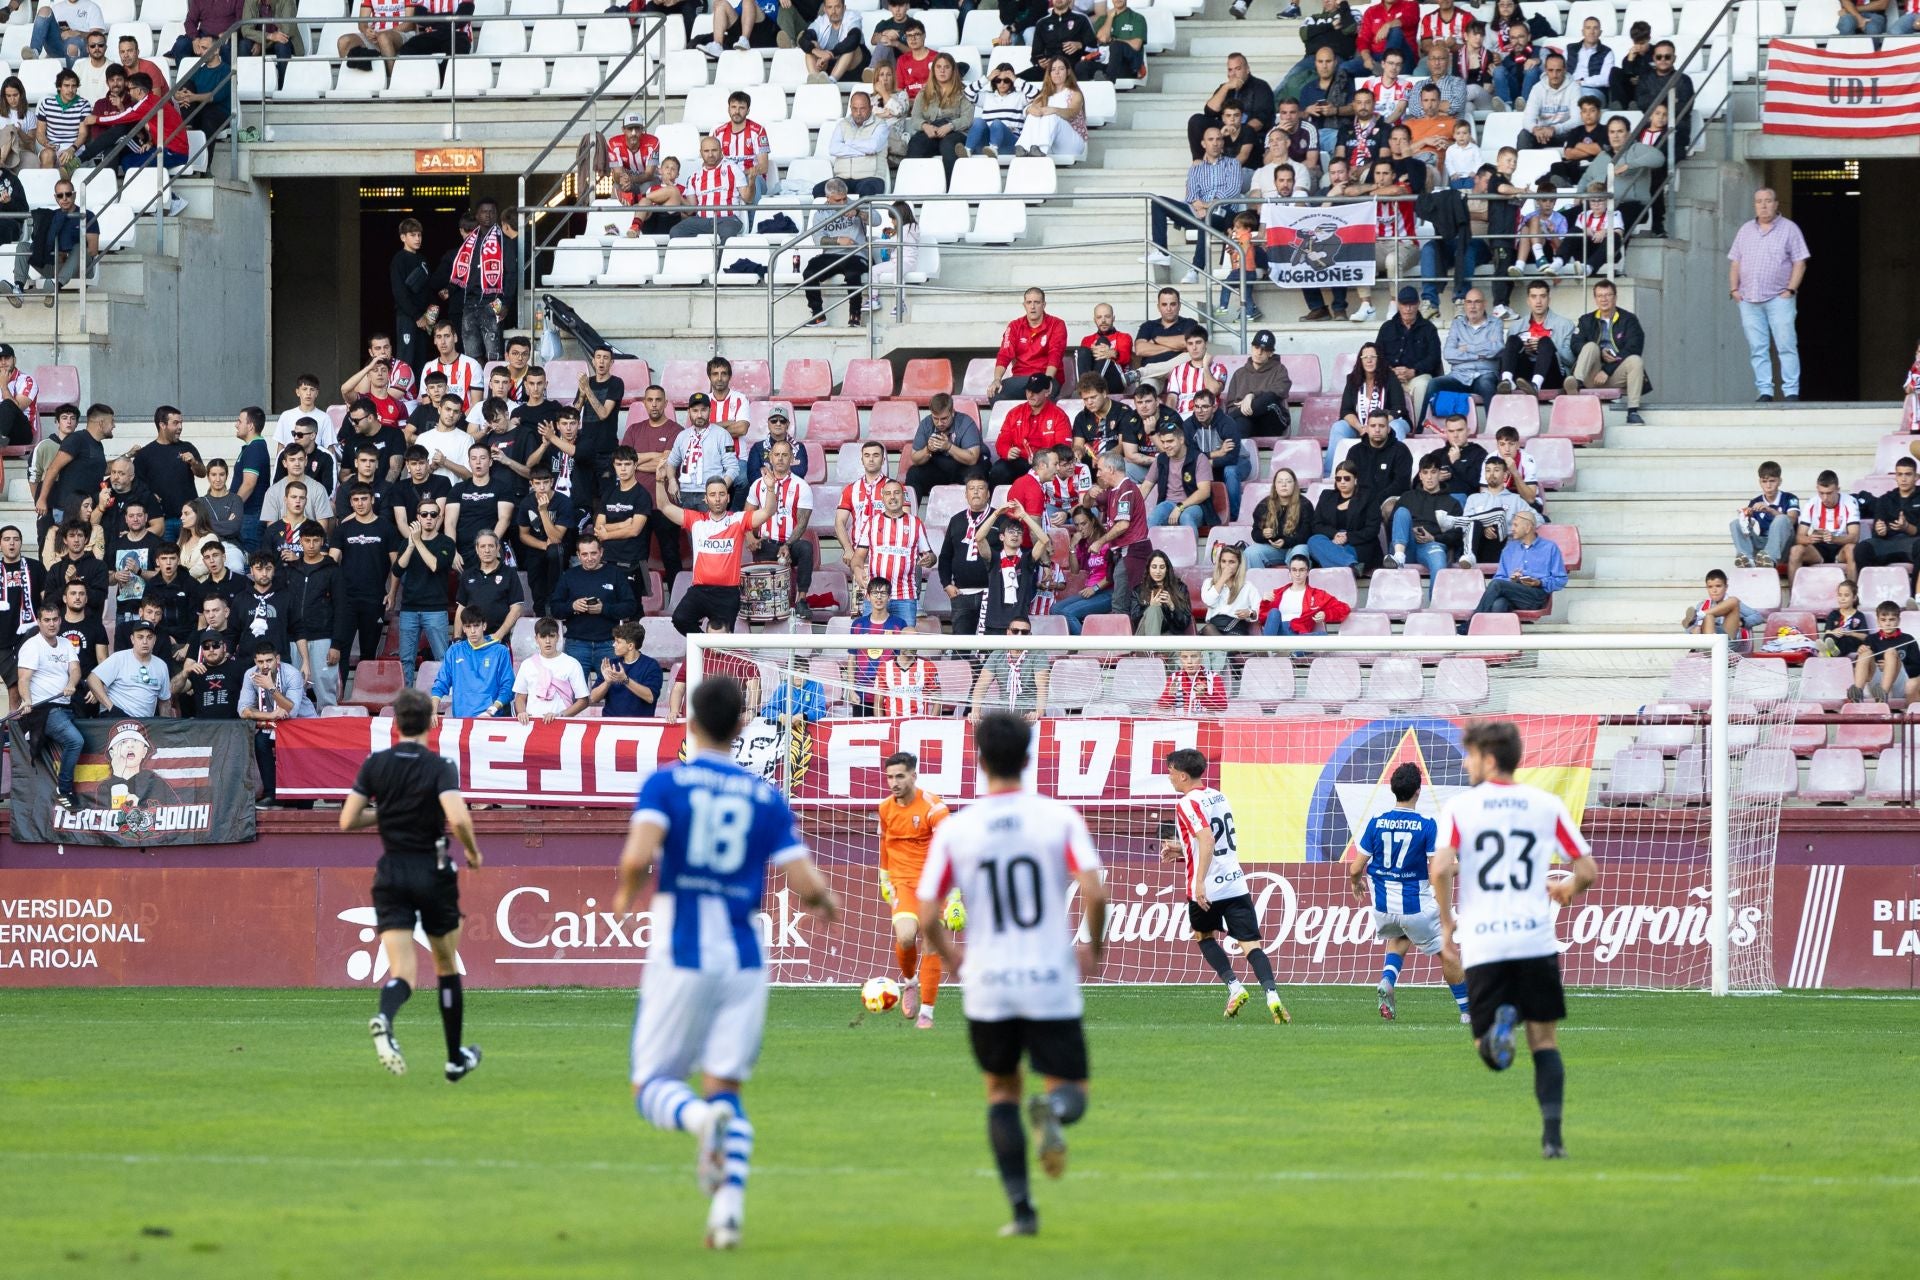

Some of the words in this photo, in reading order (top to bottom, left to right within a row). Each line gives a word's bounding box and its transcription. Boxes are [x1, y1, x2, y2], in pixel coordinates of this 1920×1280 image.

[1827, 77, 1883, 105] UDL
[1278, 265, 1363, 284] LOGROÑÉS
[828, 719, 1198, 797] FODO
[54, 805, 120, 832] TERCIO
[154, 805, 210, 831] YOUTH
[686, 788, 754, 874] 18
[1381, 831, 1413, 869] 17
[1475, 829, 1537, 892] 23
[1, 899, 113, 919] VERSIDAD
[979, 856, 1043, 934] 10
[0, 923, 146, 943] ERNACIONAL
[496, 886, 809, 949] Caixank
[30, 948, 99, 969] RIOJA
